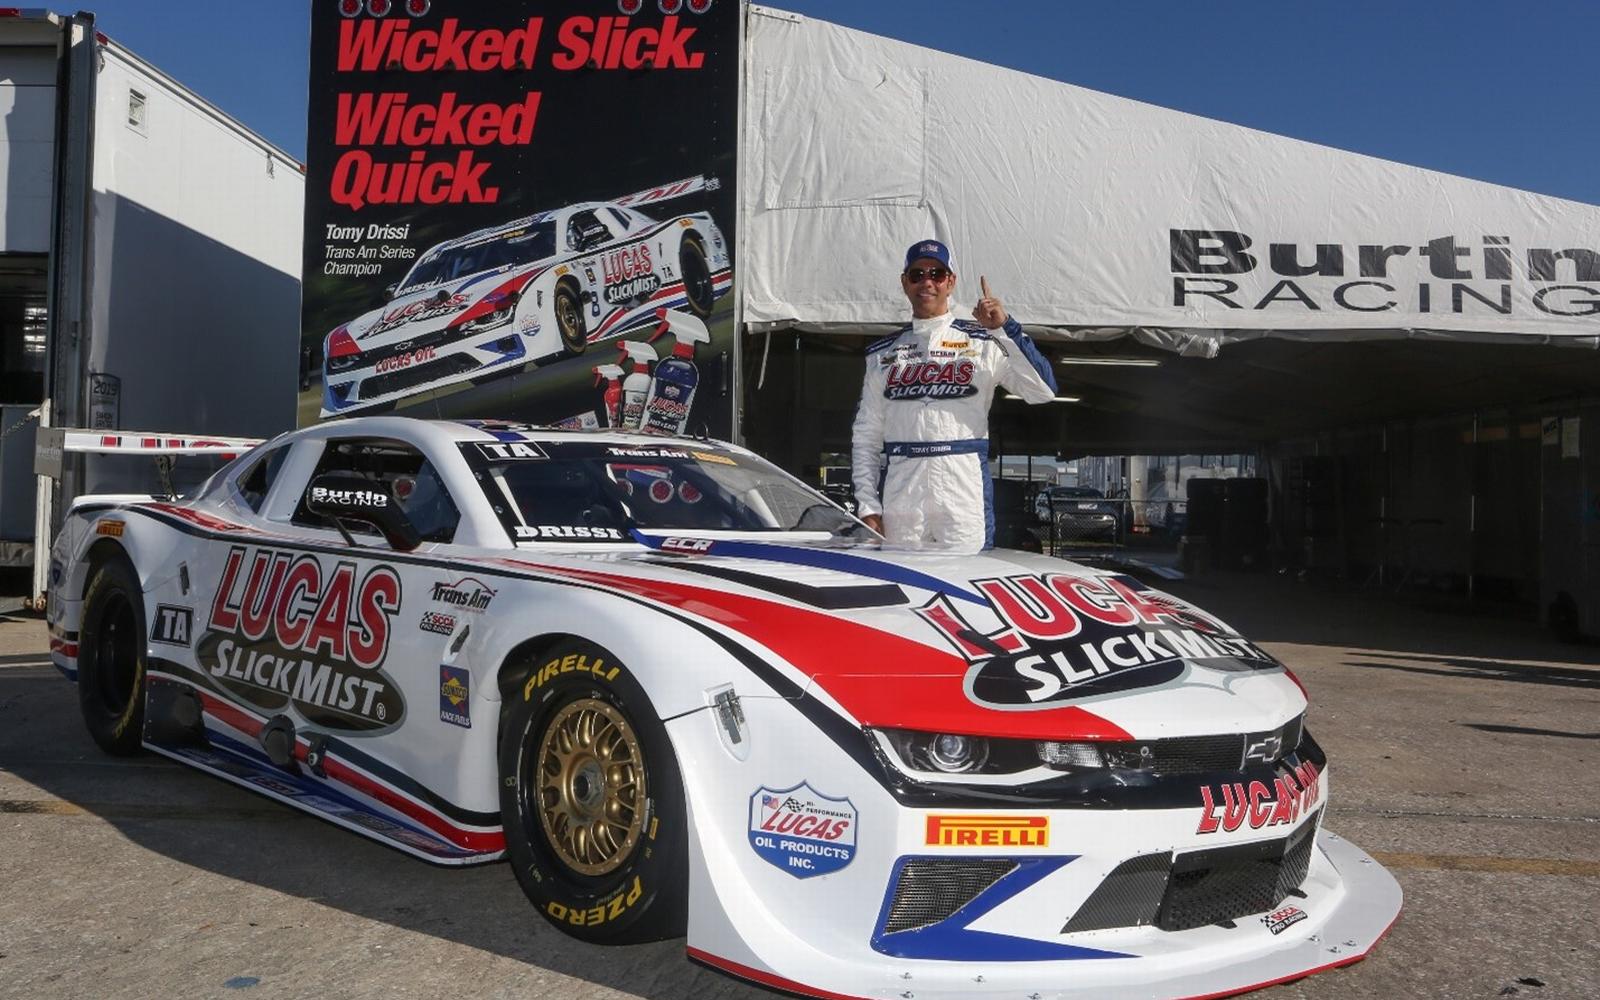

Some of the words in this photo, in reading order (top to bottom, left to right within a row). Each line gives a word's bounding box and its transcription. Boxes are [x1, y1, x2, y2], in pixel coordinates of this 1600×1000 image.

[337, 17, 543, 72] Wicked
[552, 15, 705, 69] Slick.
[334, 92, 541, 145] Wicked
[330, 150, 499, 210] Quick.
[326, 224, 364, 243] Tomy
[367, 224, 410, 240] Drissi
[325, 245, 356, 259] Trans
[356, 245, 377, 259] Am
[379, 245, 416, 259] Series
[601, 242, 653, 286] LUCAS
[1170, 228, 1600, 282] Burtin
[324, 261, 382, 278] Champion
[1173, 277, 1600, 317] RACING
[886, 360, 976, 388] LUCAS
[890, 384, 970, 400] SLICKMIST
[484, 443, 540, 458] TA
[607, 447, 658, 457] Trans
[660, 449, 690, 459] Am
[312, 486, 387, 501] Burtin
[514, 526, 623, 540] DRISSI
[661, 537, 713, 551] ECR
[208, 545, 402, 670] LUCAS
[432, 581, 470, 606] Trans
[467, 588, 492, 610] Am
[162, 609, 188, 642] TA
[432, 614, 455, 628] SCCA
[915, 574, 1221, 660] LUCAS
[211, 638, 385, 718] SLICKMIST
[524, 654, 620, 701] PIRELLI
[1015, 629, 1260, 701] SLICKMIST
[806, 807, 852, 819] PERFORMANCE
[1196, 772, 1301, 835] LUCAS
[761, 811, 849, 841] LUCAS
[926, 815, 1048, 846] PIRELLI
[755, 836, 776, 849] OIL
[780, 840, 850, 861] PRODUCTS
[788, 856, 816, 870] INC.
[1271, 907, 1297, 921] SCCA
